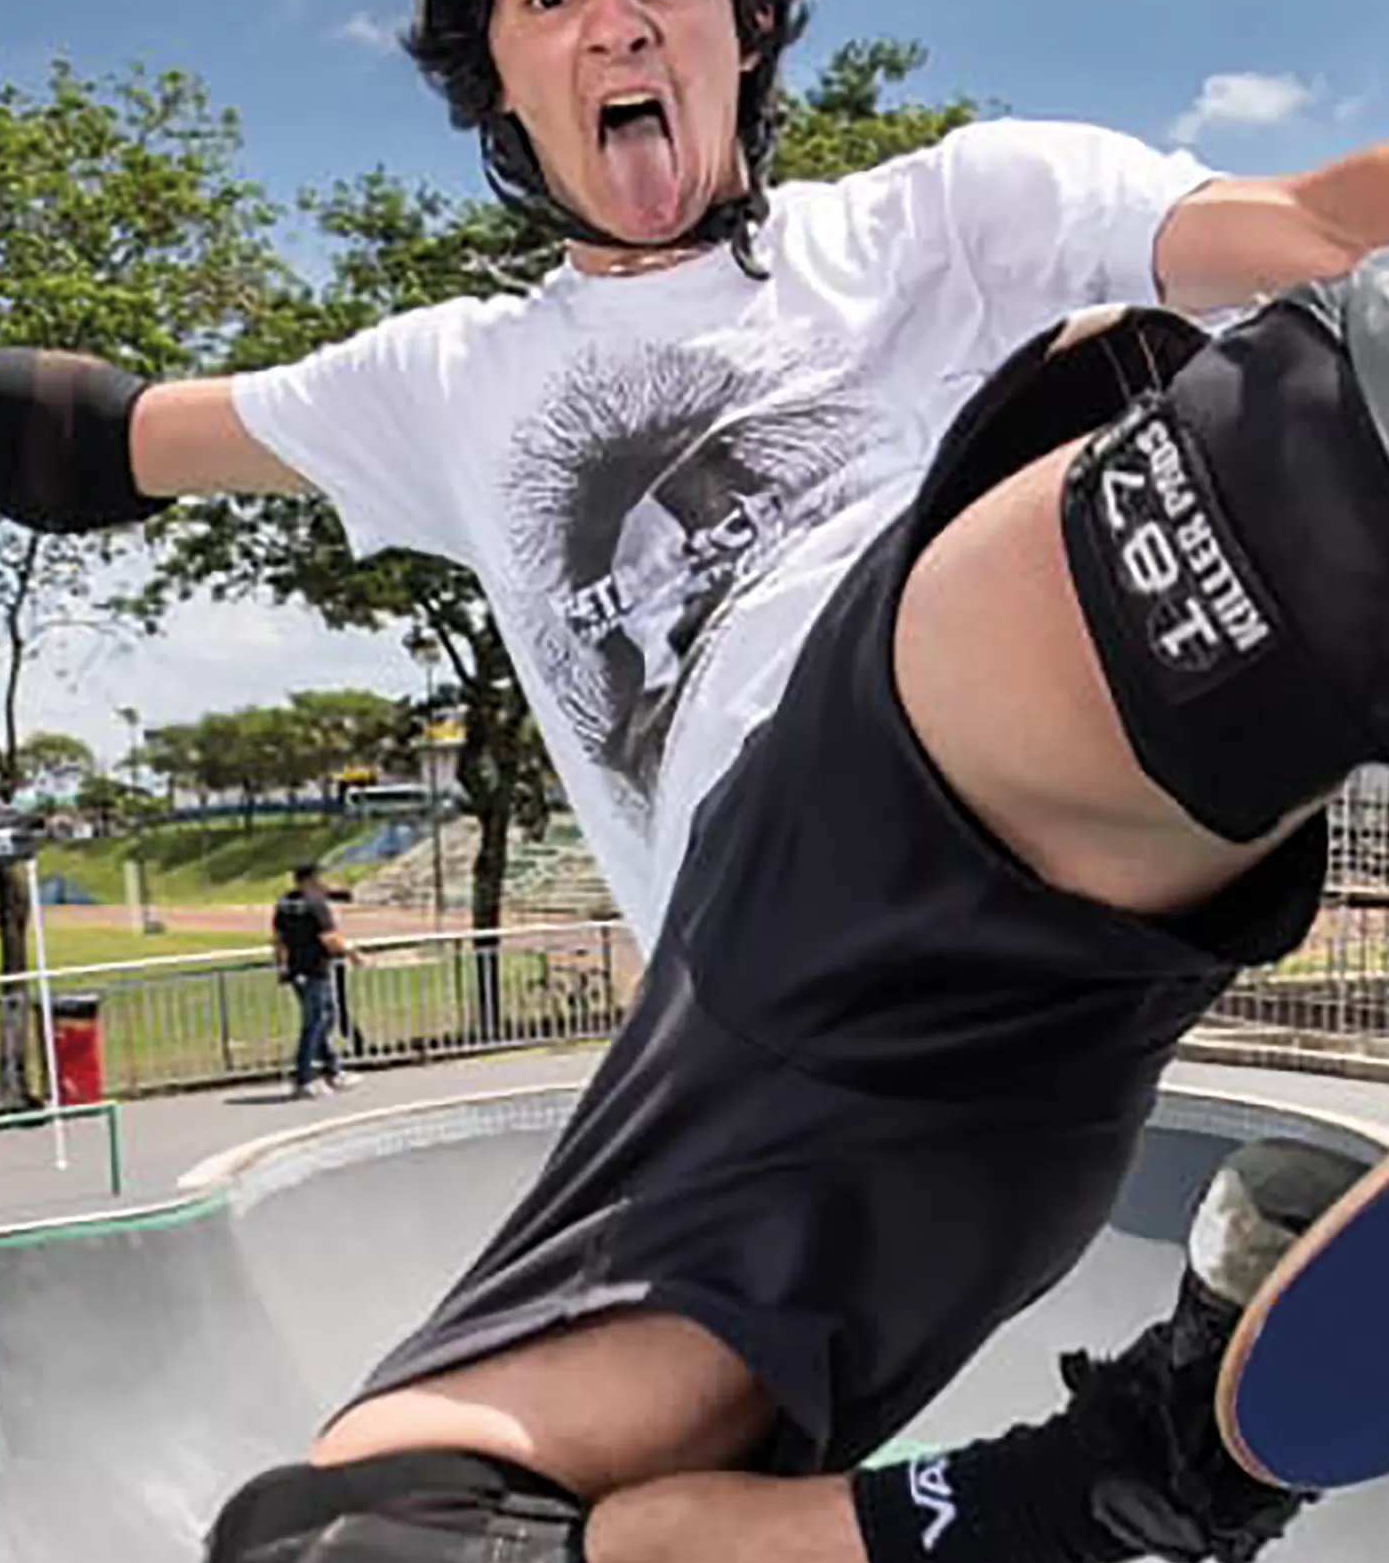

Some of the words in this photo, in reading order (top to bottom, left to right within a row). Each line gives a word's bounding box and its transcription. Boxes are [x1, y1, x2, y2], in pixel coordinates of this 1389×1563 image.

[1134, 420, 1197, 519] PADS
[1102, 469, 1218, 657] 187
[1174, 511, 1270, 652] KILLER
